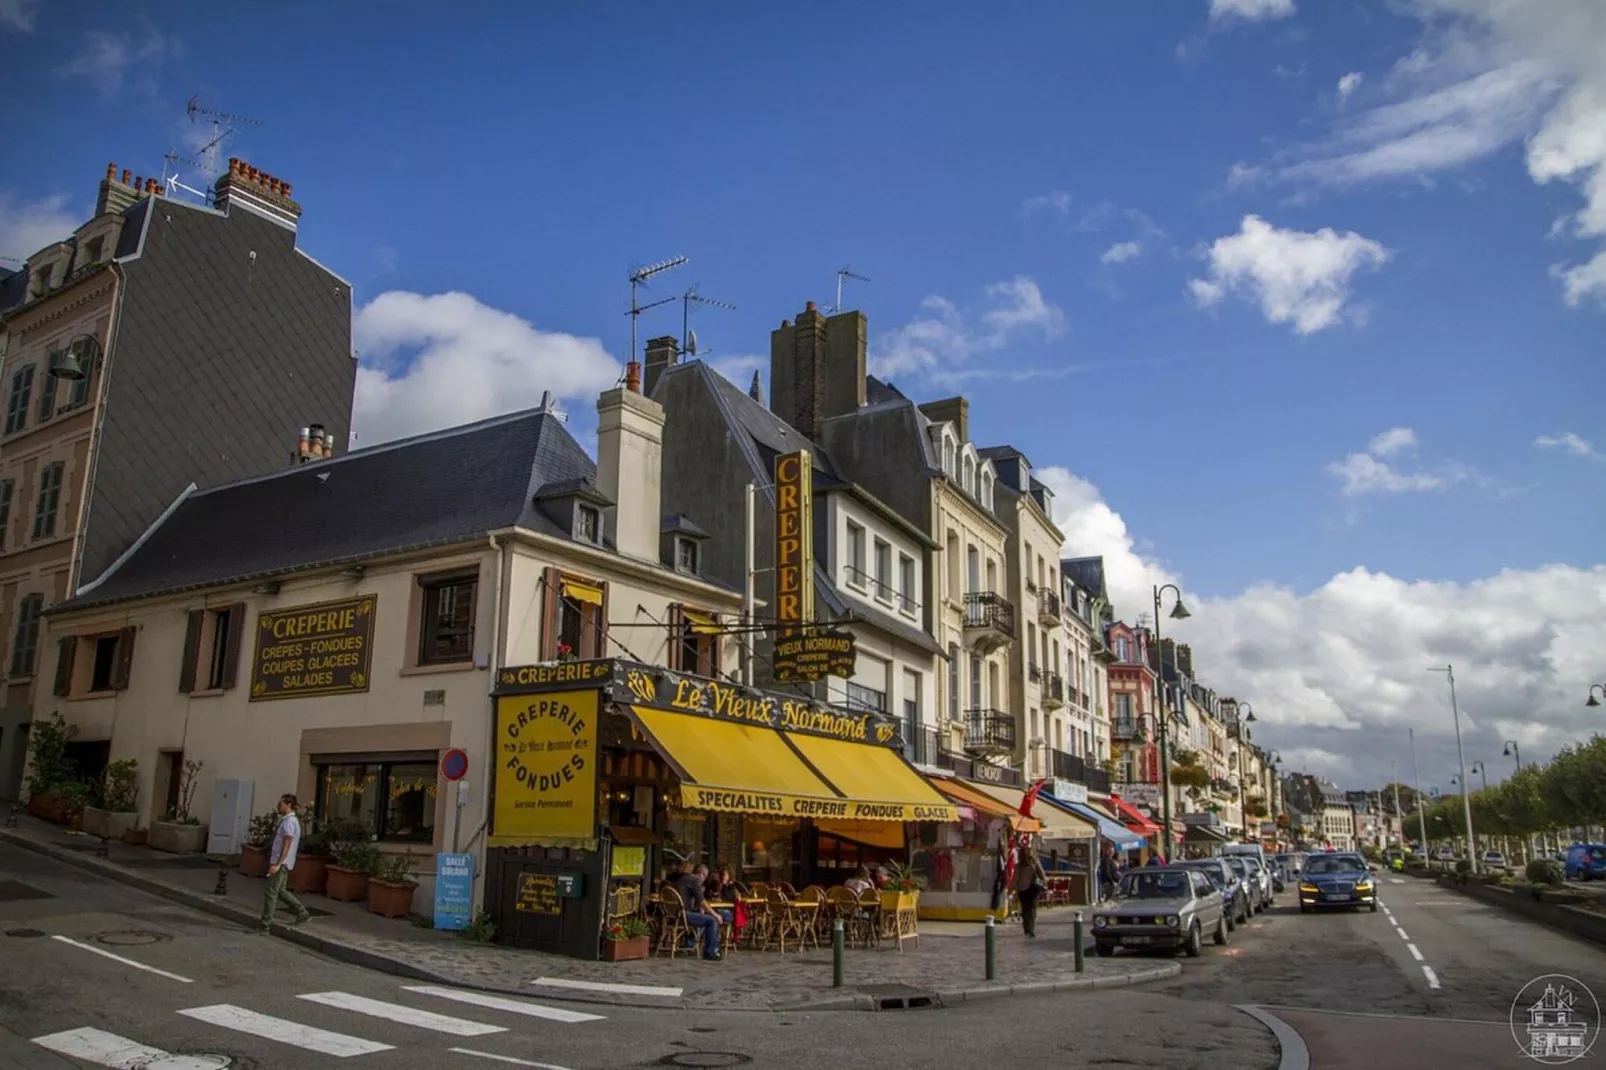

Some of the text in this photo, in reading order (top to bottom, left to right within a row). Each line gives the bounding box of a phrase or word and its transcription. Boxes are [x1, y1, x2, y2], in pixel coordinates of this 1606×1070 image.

[273, 609, 355, 639] CREPERIE
[777, 637, 850, 656] VIEUX NORMAND
[262, 653, 360, 675] COUPES GLACEES
[518, 663, 592, 684] CREPERIE
[283, 671, 333, 688] SALADES
[507, 700, 586, 738] CREPERIE
[671, 680, 869, 740] Le Vieux Normand
[507, 754, 585, 792] FONDUES
[698, 791, 950, 819] SPECIALITES CREPERIE FONDUES GLACES
